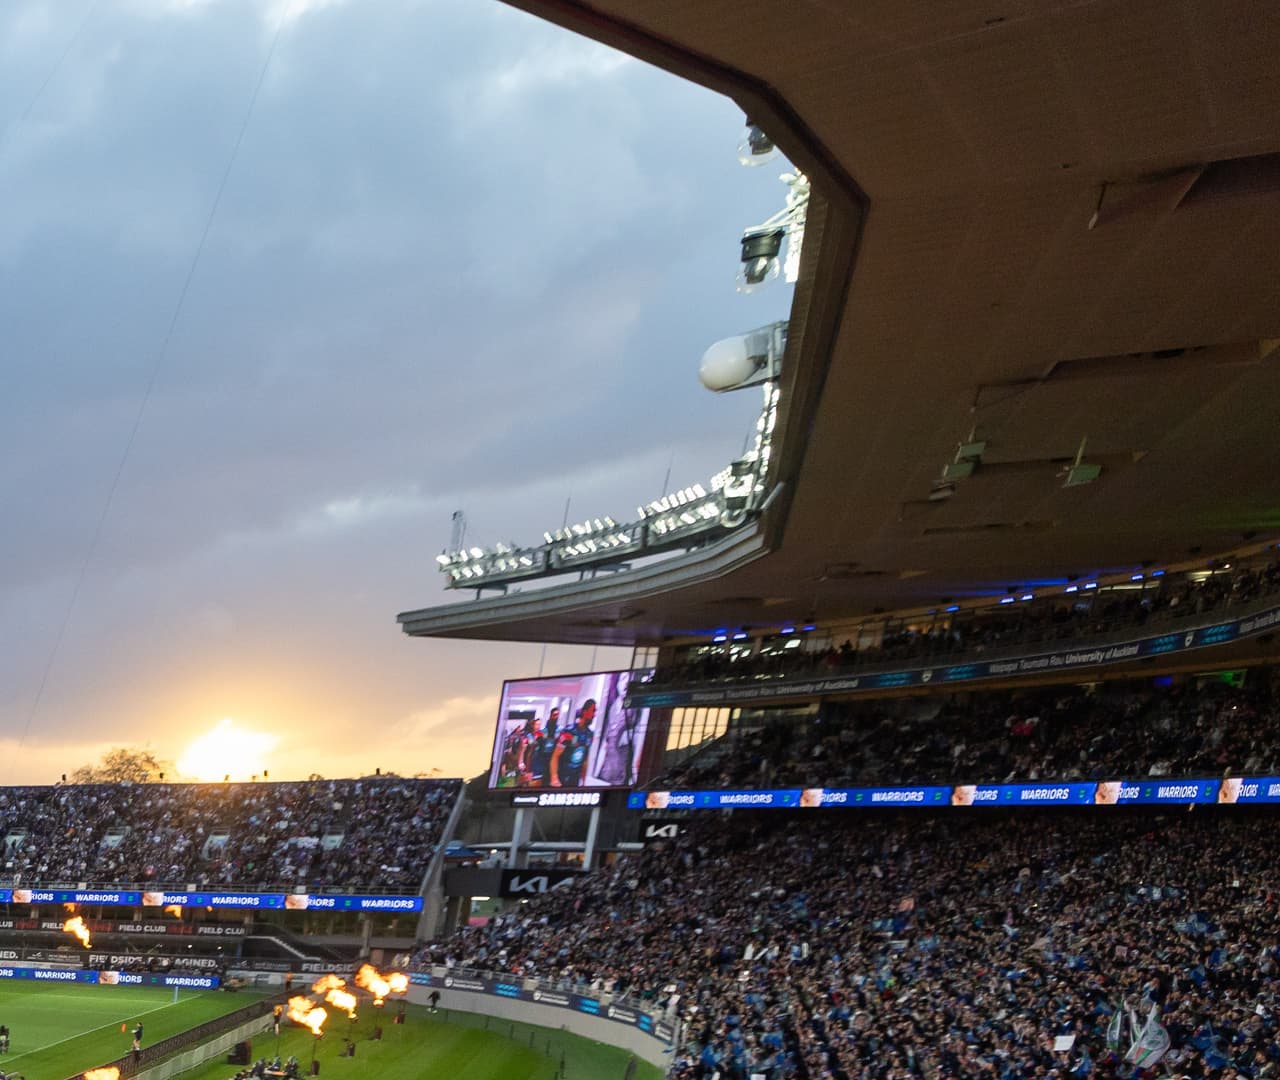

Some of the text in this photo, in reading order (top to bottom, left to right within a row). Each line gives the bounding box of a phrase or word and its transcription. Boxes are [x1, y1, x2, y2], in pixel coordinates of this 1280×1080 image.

[1065, 652, 1103, 666] University
[1104, 650, 1113, 661] of
[538, 793, 601, 806] SAMSUNG
[668, 793, 695, 804] RIORS
[720, 793, 772, 804] WARRIORS
[821, 792, 848, 802] RIORS
[871, 791, 924, 802] WARRIORS
[973, 790, 999, 801] RIORS
[1021, 788, 1070, 800] WARRIORS
[1118, 787, 1140, 799] RIORS
[1157, 785, 1198, 798] WARRIORS
[1238, 784, 1259, 798] RIORS
[31, 893, 54, 901] RIORS
[75, 894, 119, 902] WARRIORS
[163, 895, 188, 904] RIORS
[211, 896, 259, 904] WARRIORS
[309, 898, 336, 907] RIORS
[361, 899, 415, 908] WARRIORS
[118, 924, 142, 932] FIELD
[198, 926, 223, 934] FIELD
[34, 971, 77, 980] WARRIORS
[118, 974, 143, 983] RIORS
[165, 977, 212, 987] WARRIORS
